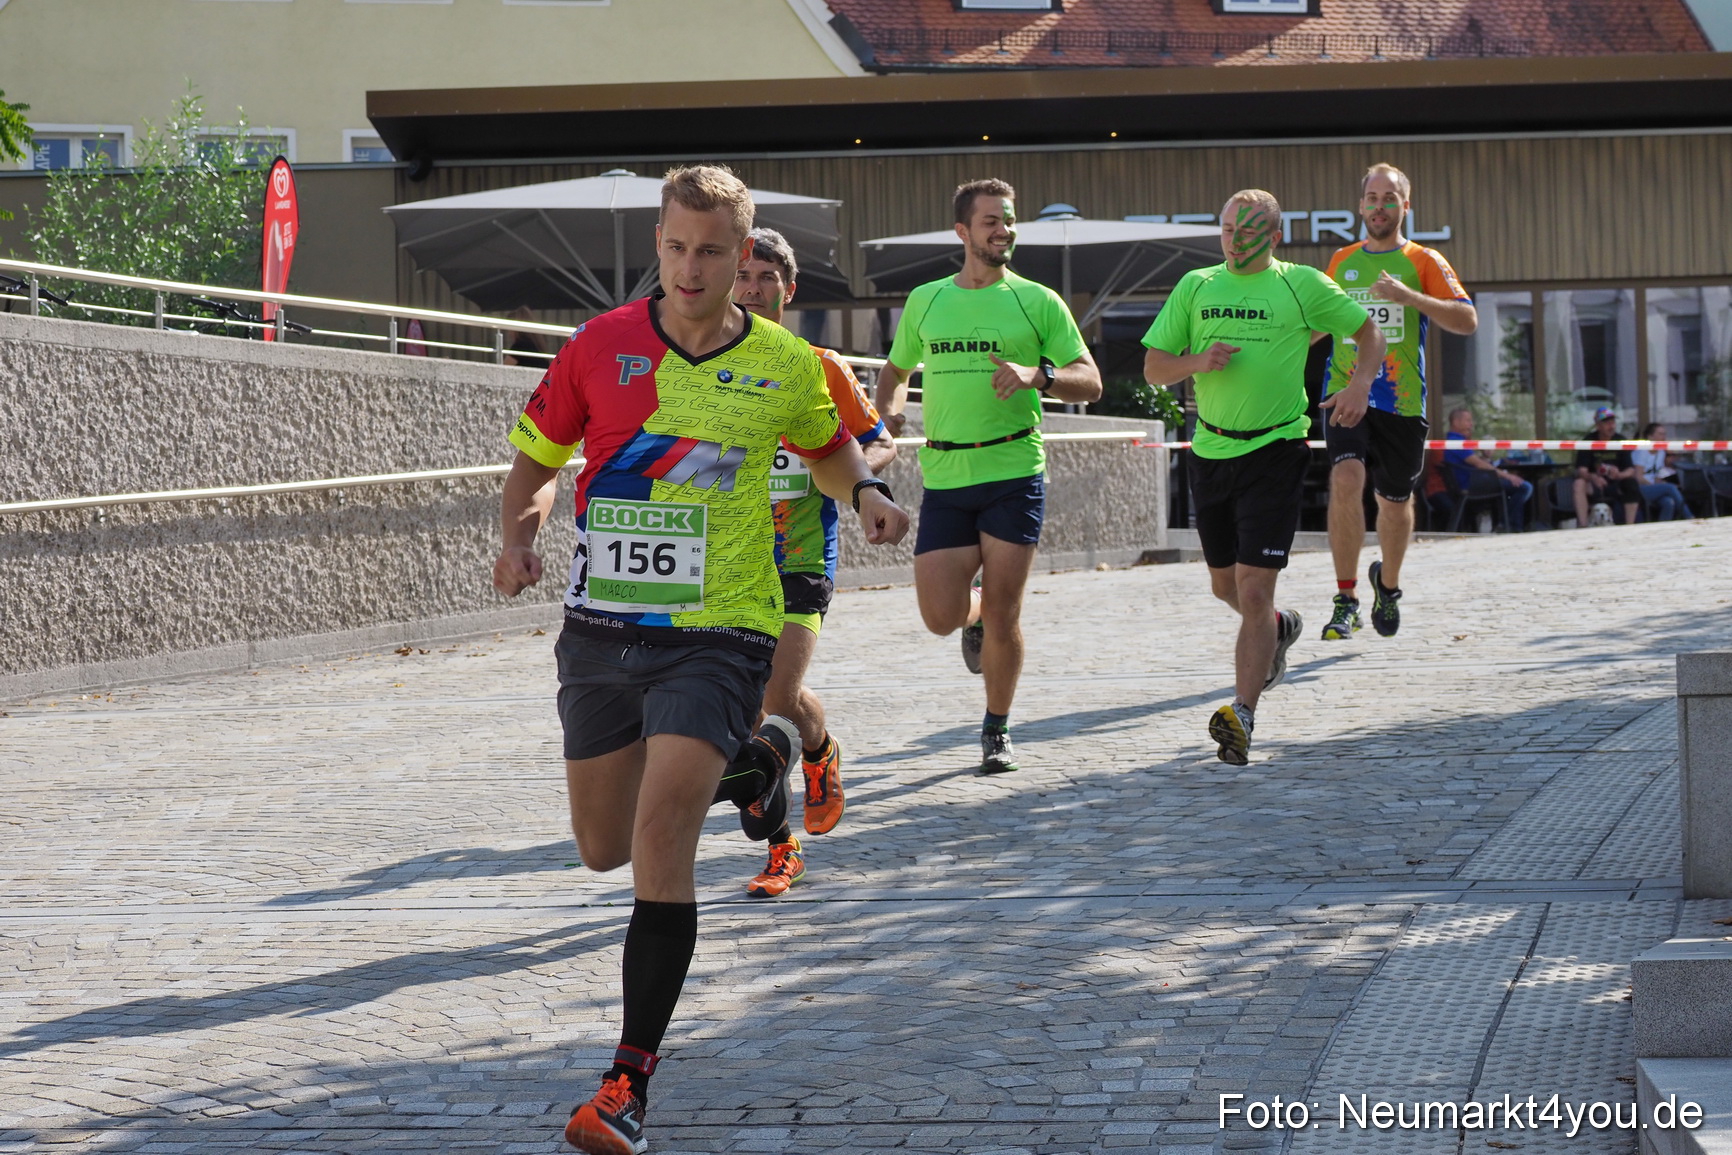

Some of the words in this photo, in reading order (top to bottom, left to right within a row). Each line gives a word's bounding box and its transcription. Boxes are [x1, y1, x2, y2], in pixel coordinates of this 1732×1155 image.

[1201, 307, 1268, 320] BRANDL
[930, 341, 1002, 355] BRANDL
[594, 503, 695, 533] BOCK
[607, 540, 676, 576] 156
[600, 582, 637, 599] MARCO
